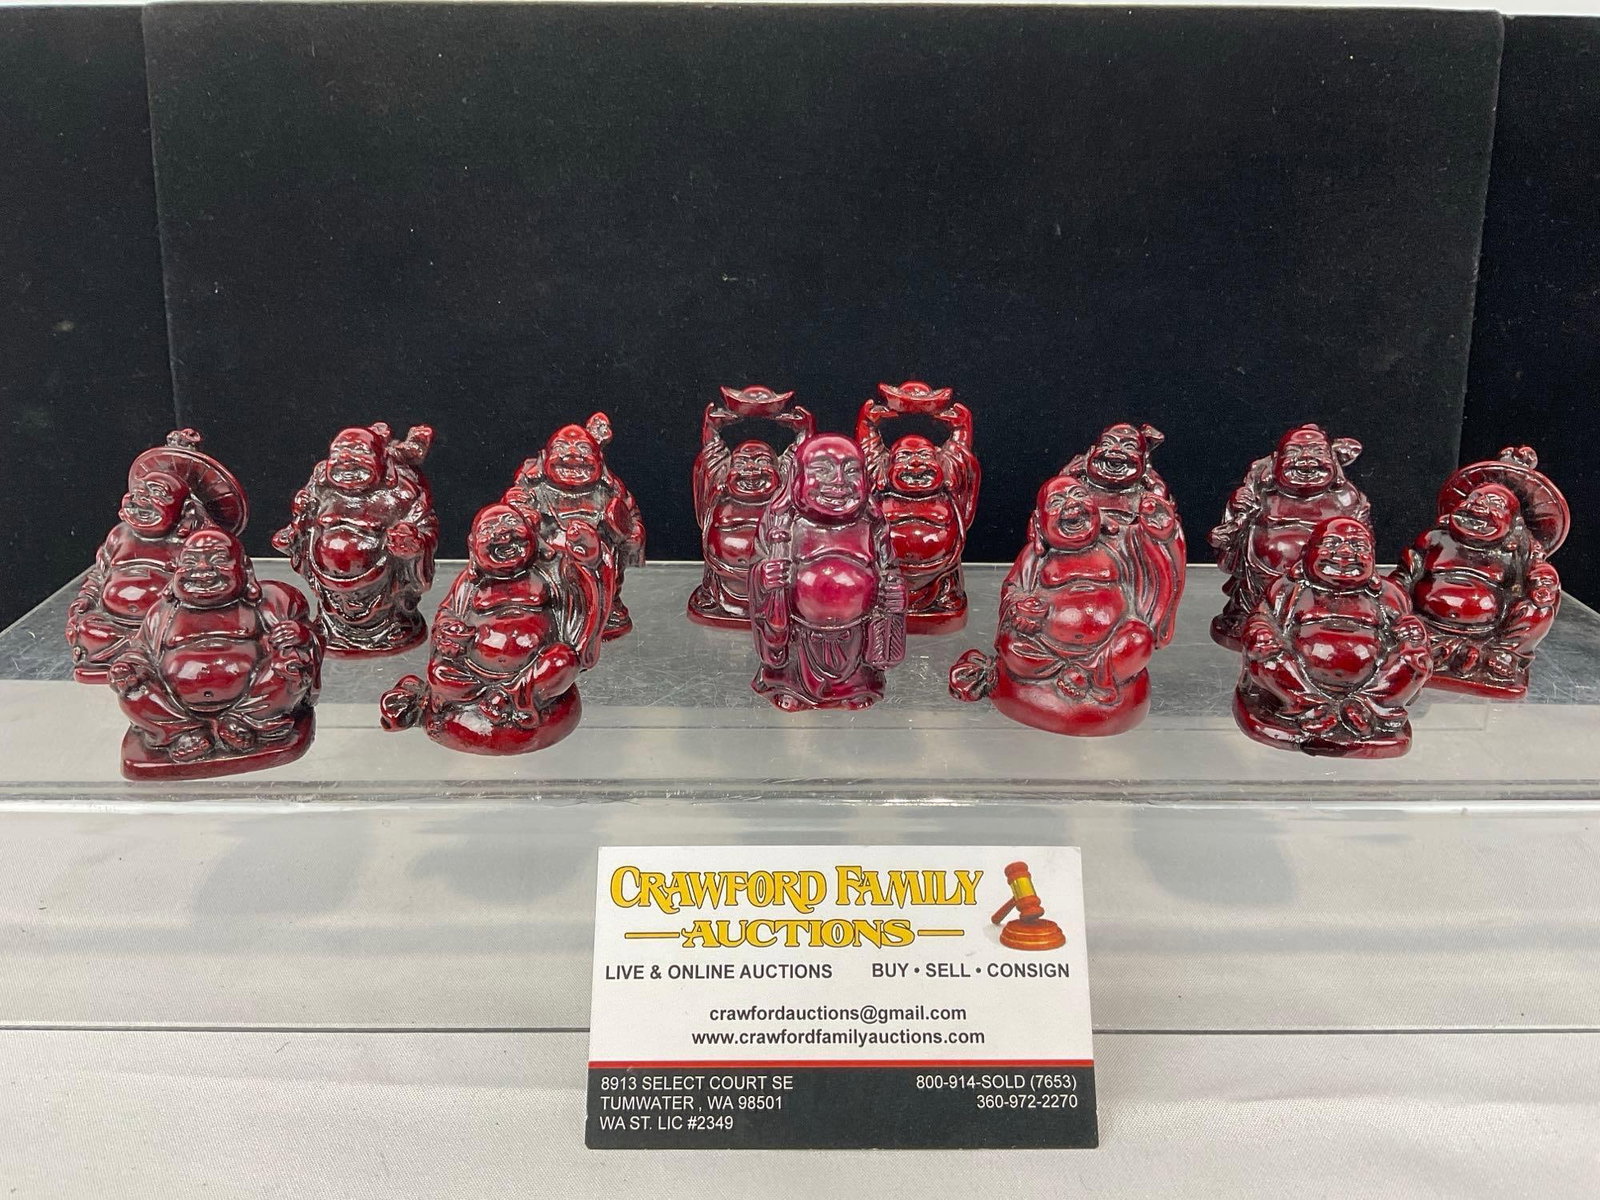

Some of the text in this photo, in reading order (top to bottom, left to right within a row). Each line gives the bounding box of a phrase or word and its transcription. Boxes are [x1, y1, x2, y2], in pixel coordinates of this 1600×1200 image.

[610, 865, 984, 914] CRAWFORD FAMILY
[681, 919, 915, 949] AUCTIONS
[605, 963, 833, 980] LIVE & ONLINE AUCTIONS
[871, 962, 1070, 978] BUY SELL CONSIGN
[709, 1004, 967, 1025] crawfordauctions@gmail.com
[691, 1028, 985, 1048] www.crawfordfamilyauctions.com
[600, 1074, 794, 1091] 8913 SELECT COURT SE
[916, 1074, 1077, 1092] 800-914-SOLD (7653)
[599, 1095, 695, 1111] TUMWATER
[707, 1095, 734, 1110] WA
[738, 1095, 782, 1110] 98501
[976, 1093, 1078, 1109] 360-972-2270
[599, 1115, 734, 1131] WA ST. LIC #2349
